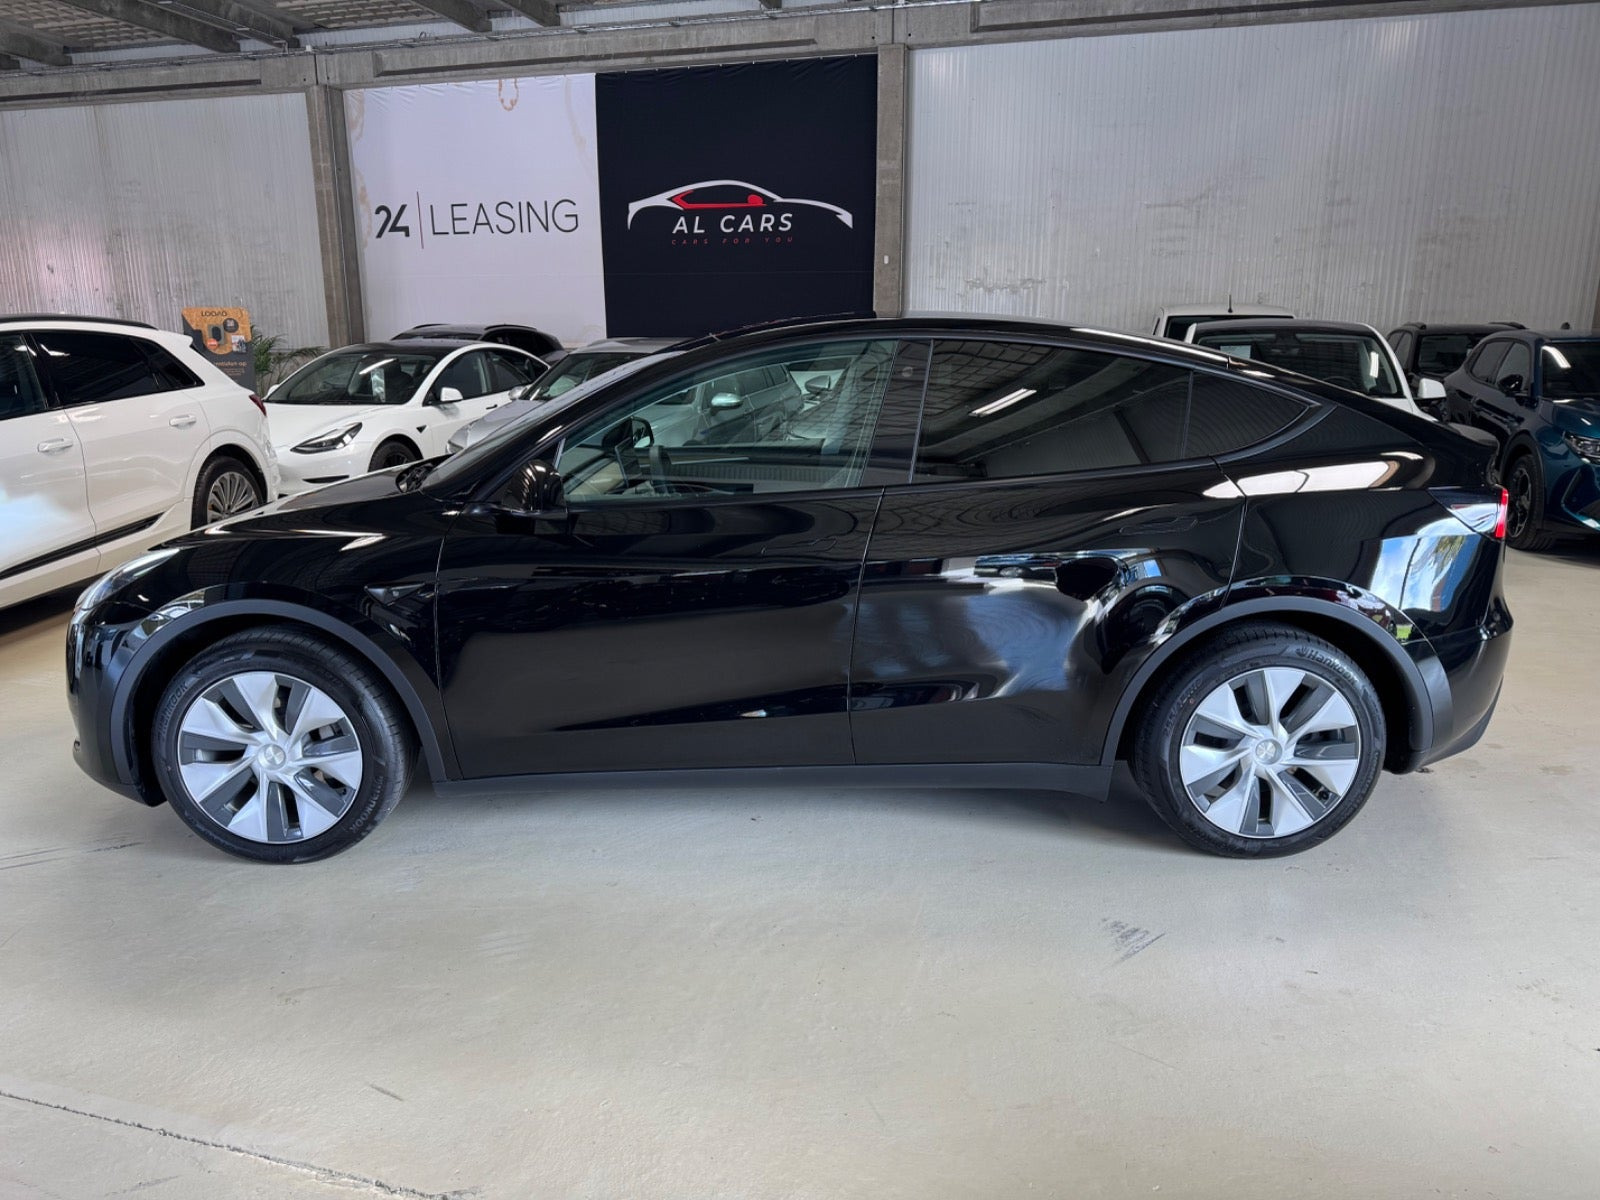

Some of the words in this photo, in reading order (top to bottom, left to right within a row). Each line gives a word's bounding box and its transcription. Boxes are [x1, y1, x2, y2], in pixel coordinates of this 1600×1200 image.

[374, 204, 410, 239] 24
[430, 199, 579, 235] LEASING
[672, 216, 706, 234] AL
[720, 213, 793, 234] CARS
[671, 238, 709, 246] CARS
[765, 236, 794, 244] YOU
